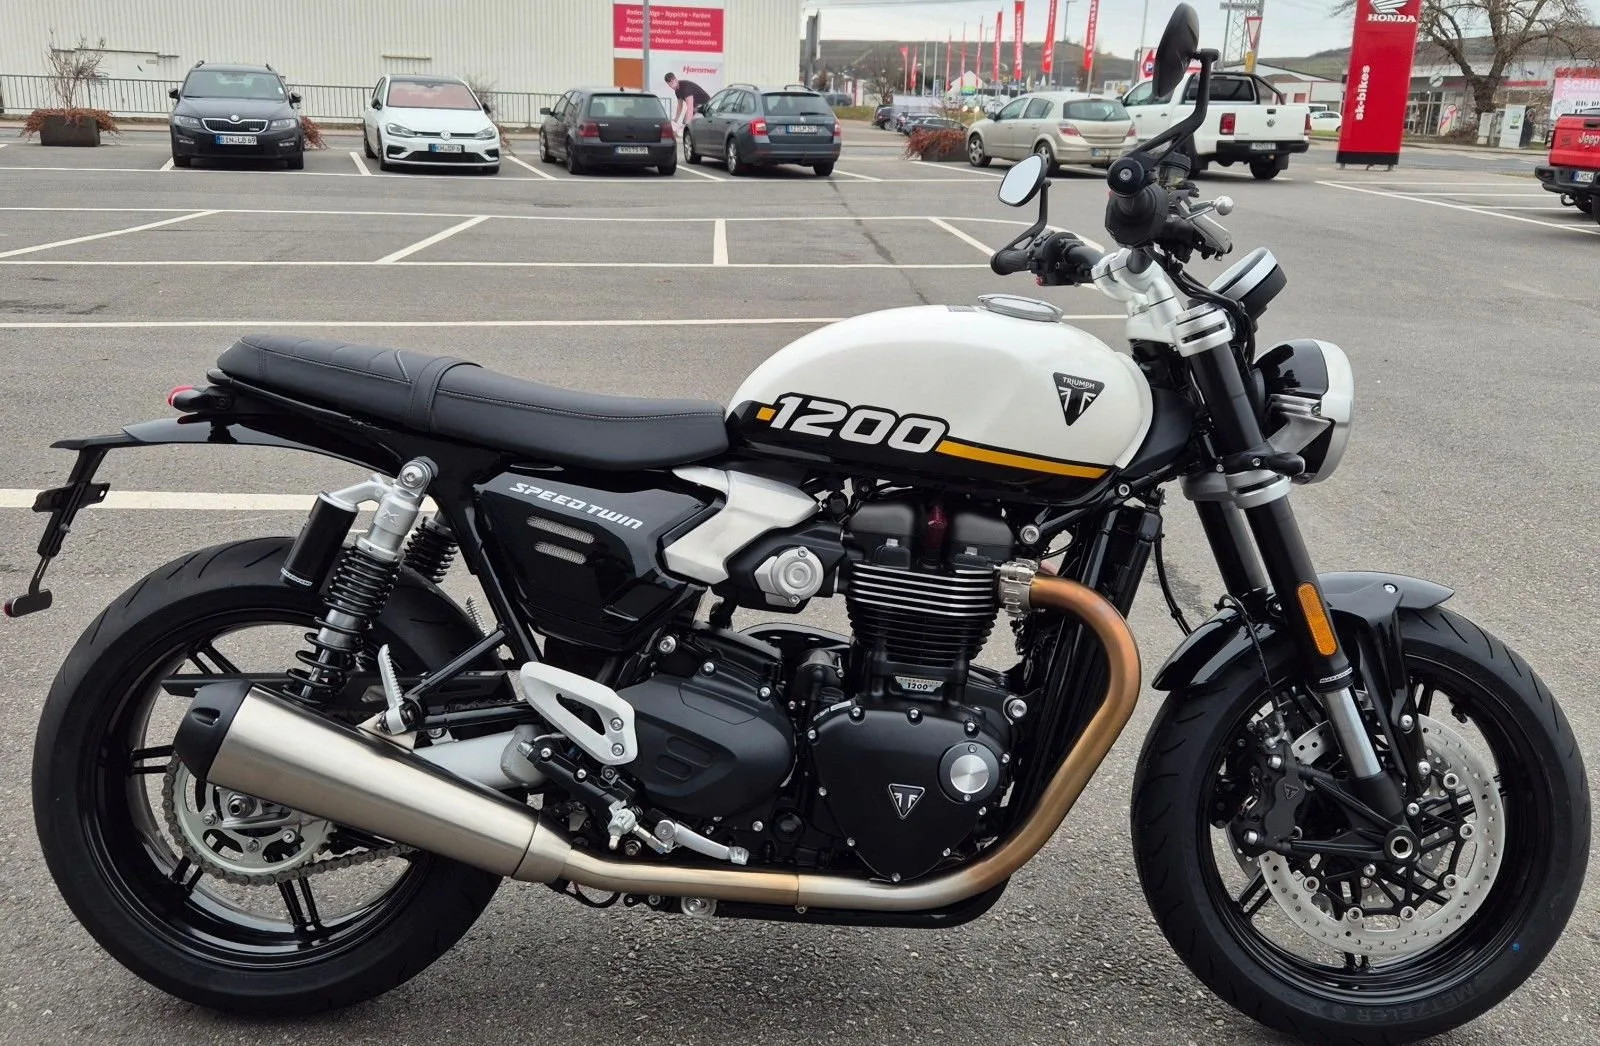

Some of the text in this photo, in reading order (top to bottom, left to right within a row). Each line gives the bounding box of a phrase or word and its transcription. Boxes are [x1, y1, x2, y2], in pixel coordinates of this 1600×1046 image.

[1367, 13, 1417, 22] HONDA
[683, 65, 718, 74] Hammer
[1355, 65, 1370, 120] sk-bikes
[1562, 79, 1600, 91] SCHU
[1579, 131, 1600, 147] Jeep
[1063, 376, 1095, 390] TRIUMPH
[769, 394, 948, 454] 1200
[509, 482, 644, 530] SPEED TWIN
[907, 682, 929, 691] 1200
[1357, 982, 1475, 1023] METZELER
